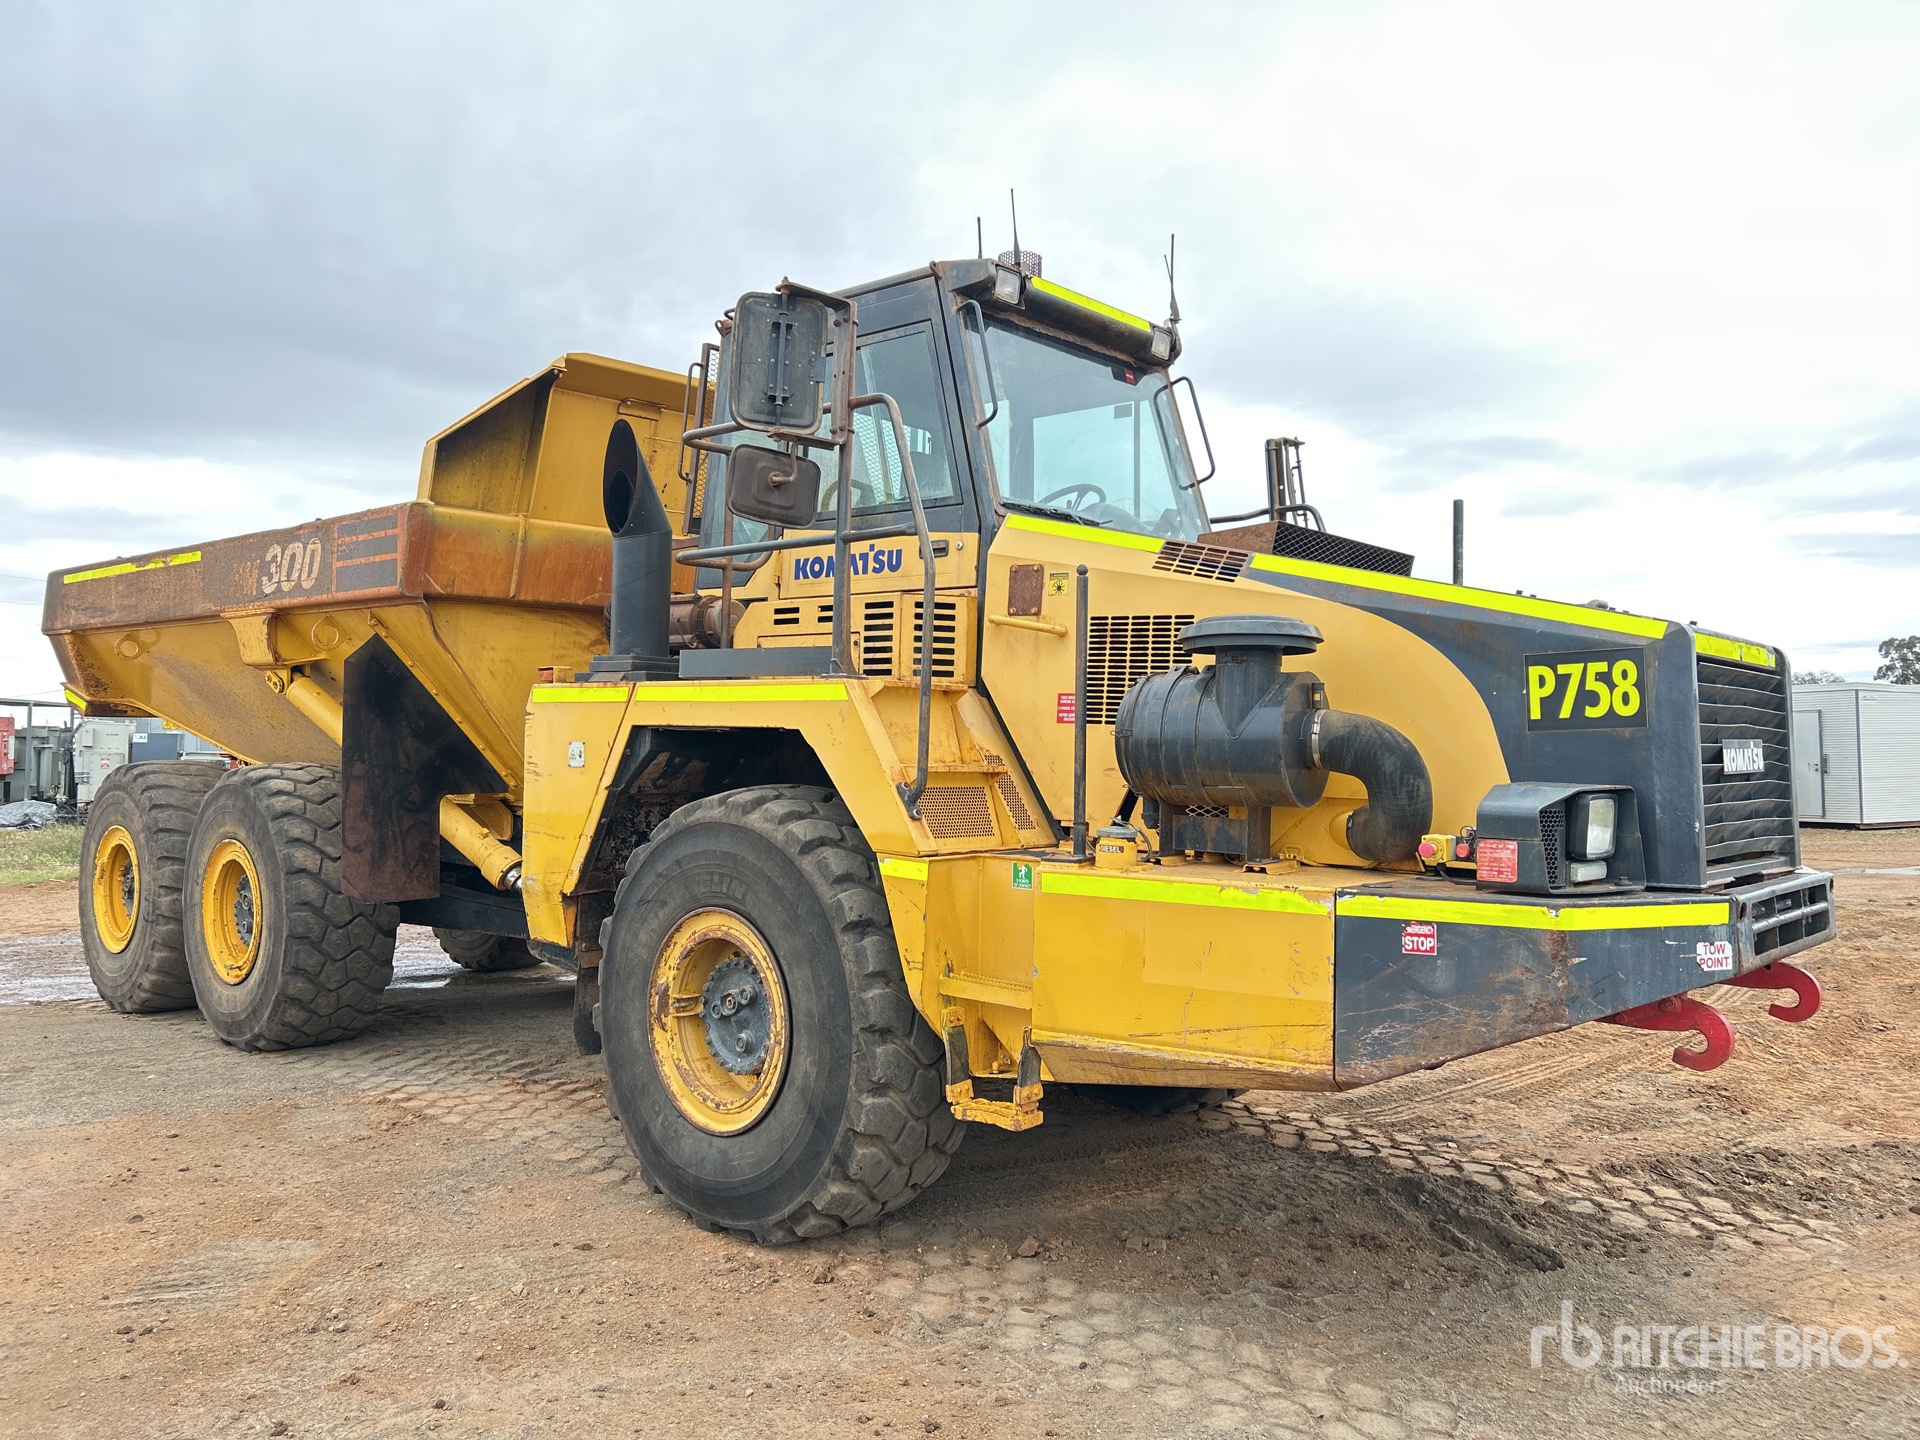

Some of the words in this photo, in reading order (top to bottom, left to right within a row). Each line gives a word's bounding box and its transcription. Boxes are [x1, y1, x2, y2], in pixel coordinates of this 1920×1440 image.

[1528, 659, 1640, 720] P758
[1723, 740, 1764, 772] KOMATSU
[1100, 845, 1121, 853] DIESEL
[1404, 936, 1435, 952] STOP
[1702, 944, 1726, 955] TOW
[1699, 956, 1730, 968] POINT
